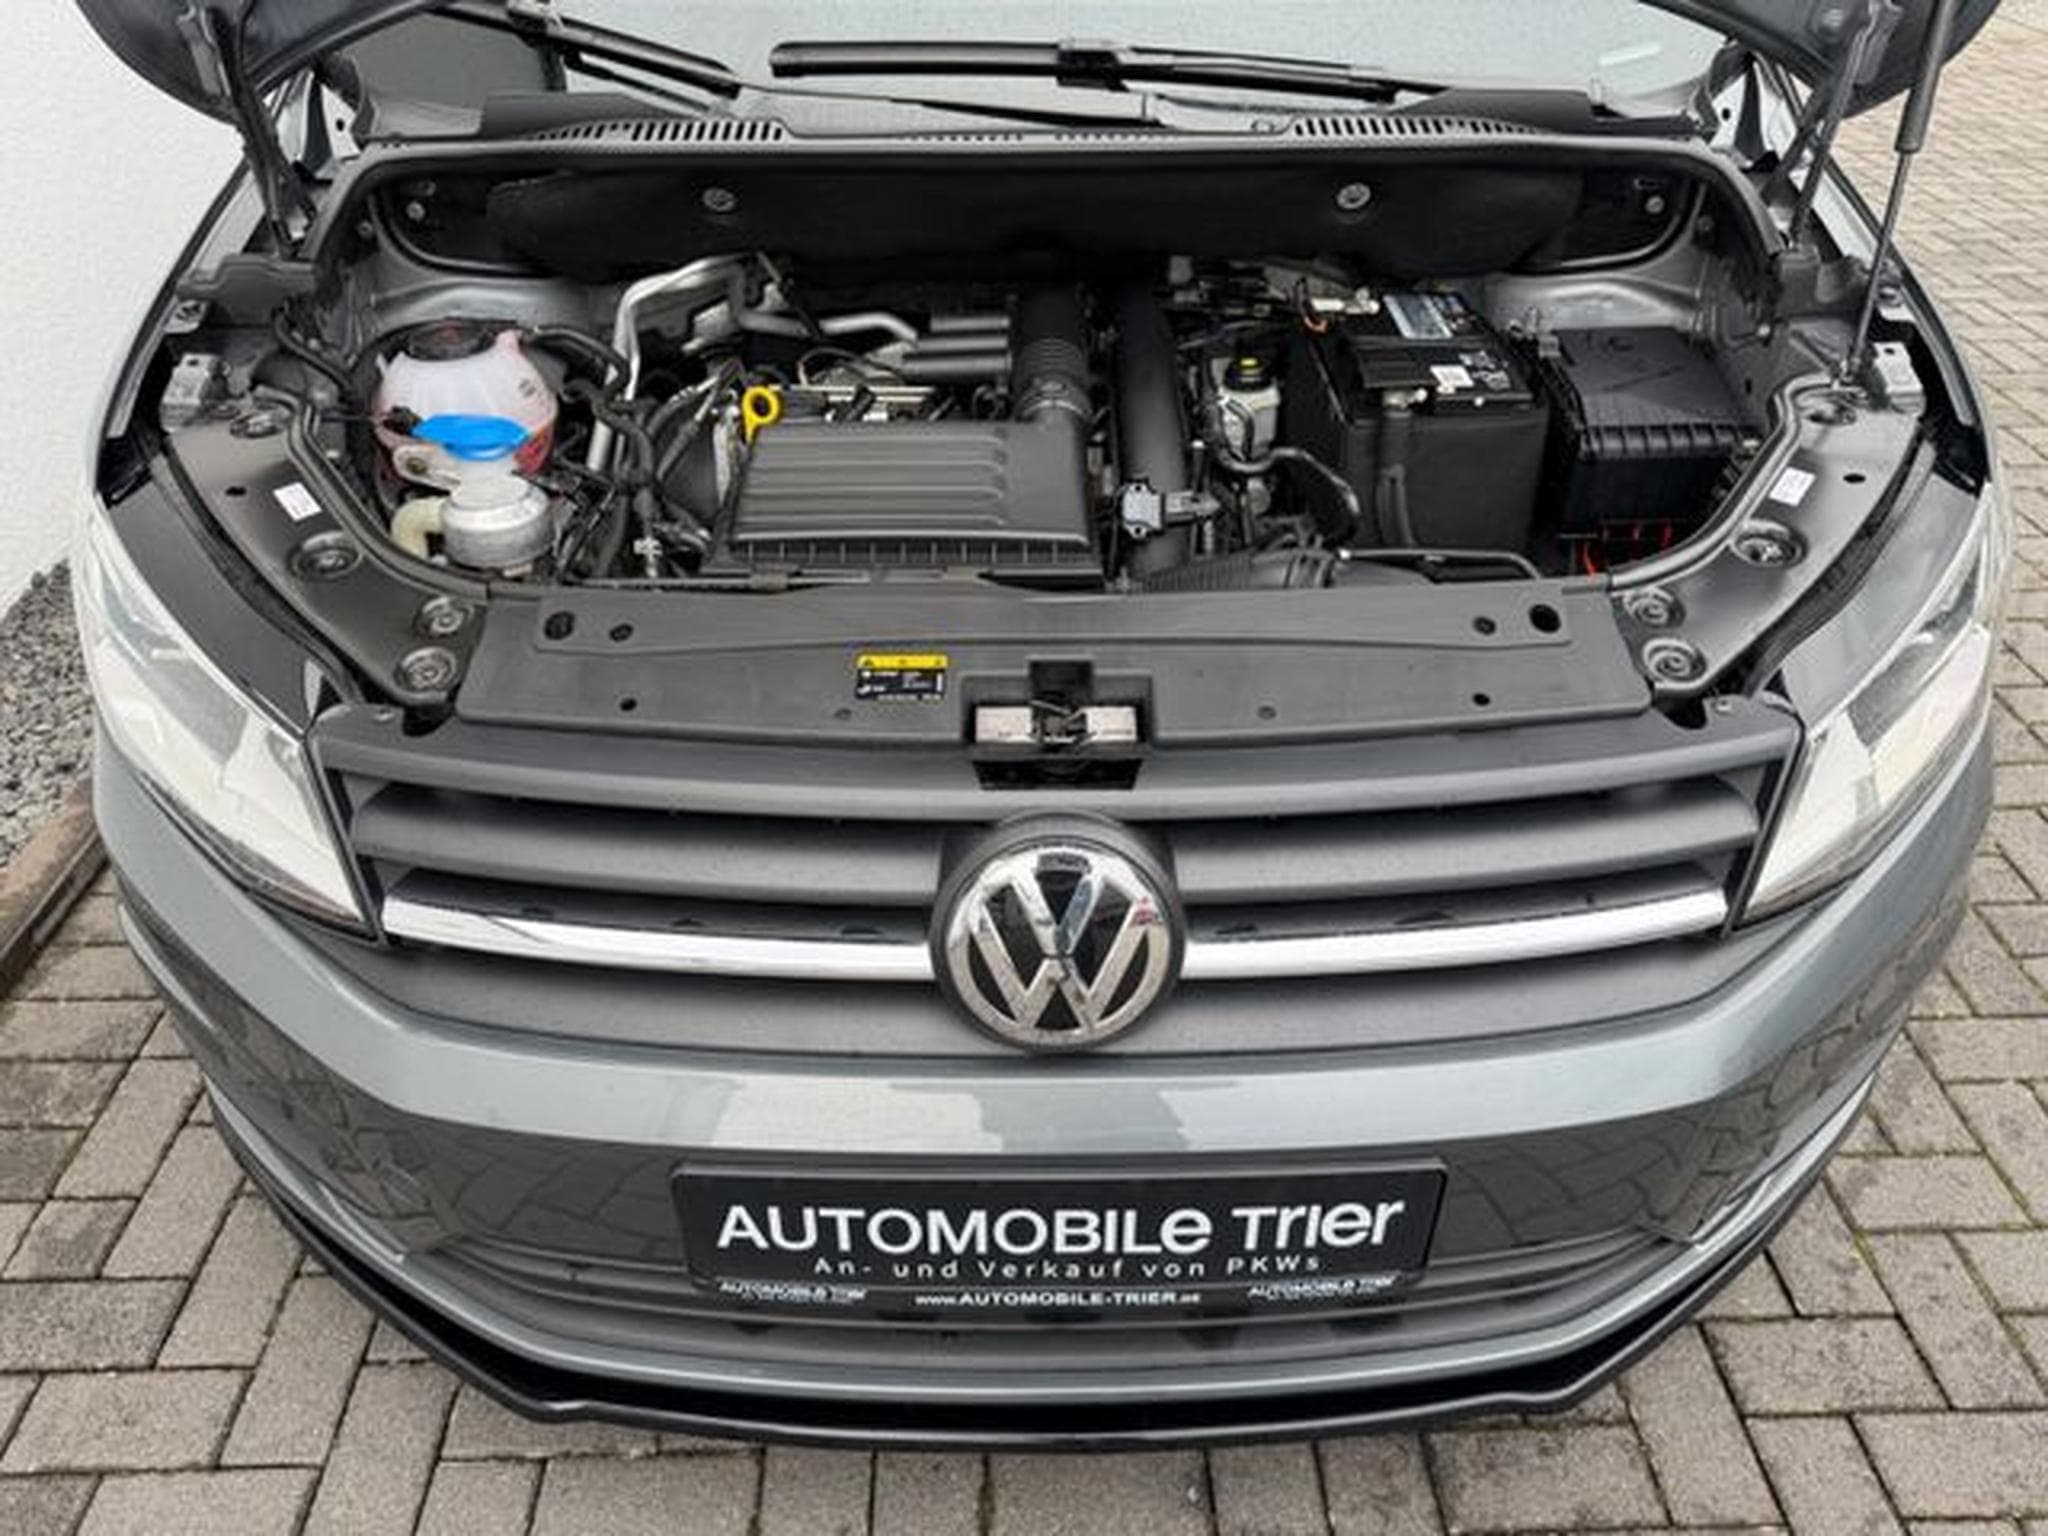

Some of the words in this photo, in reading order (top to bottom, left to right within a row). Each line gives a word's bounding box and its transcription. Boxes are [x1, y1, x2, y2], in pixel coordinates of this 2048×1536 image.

[814, 1256, 871, 1275] An-
[893, 1260, 959, 1279] und
[977, 1257, 1123, 1279] Verkauf
[1141, 1262, 1205, 1280] von
